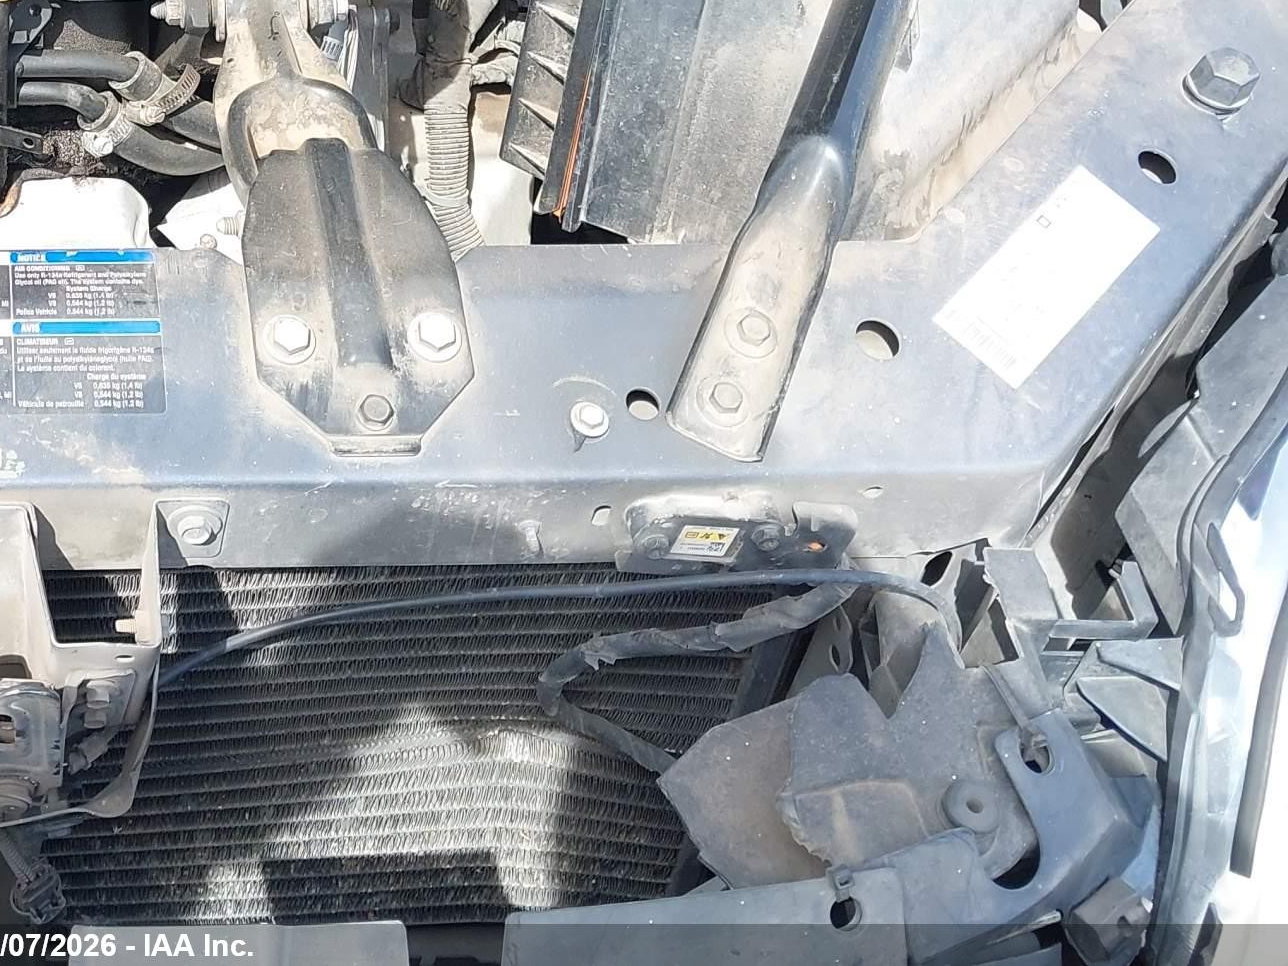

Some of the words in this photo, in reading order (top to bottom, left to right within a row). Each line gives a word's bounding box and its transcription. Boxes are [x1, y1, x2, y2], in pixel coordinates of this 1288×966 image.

[26, 272, 40, 280] only
[63, 272, 98, 280] Refrigerant
[21, 322, 41, 333] AVIS
[39, 346, 73, 354] seulement
[132, 346, 155, 354] R-134a
[24, 355, 33, 363] de
[52, 364, 79, 372] contient
[79, 364, 88, 372] du
[86, 373, 111, 381] Charge
[112, 382, 121, 390] kg
[112, 391, 121, 399] kg
[45, 400, 54, 408] de
[112, 400, 121, 409] kg
